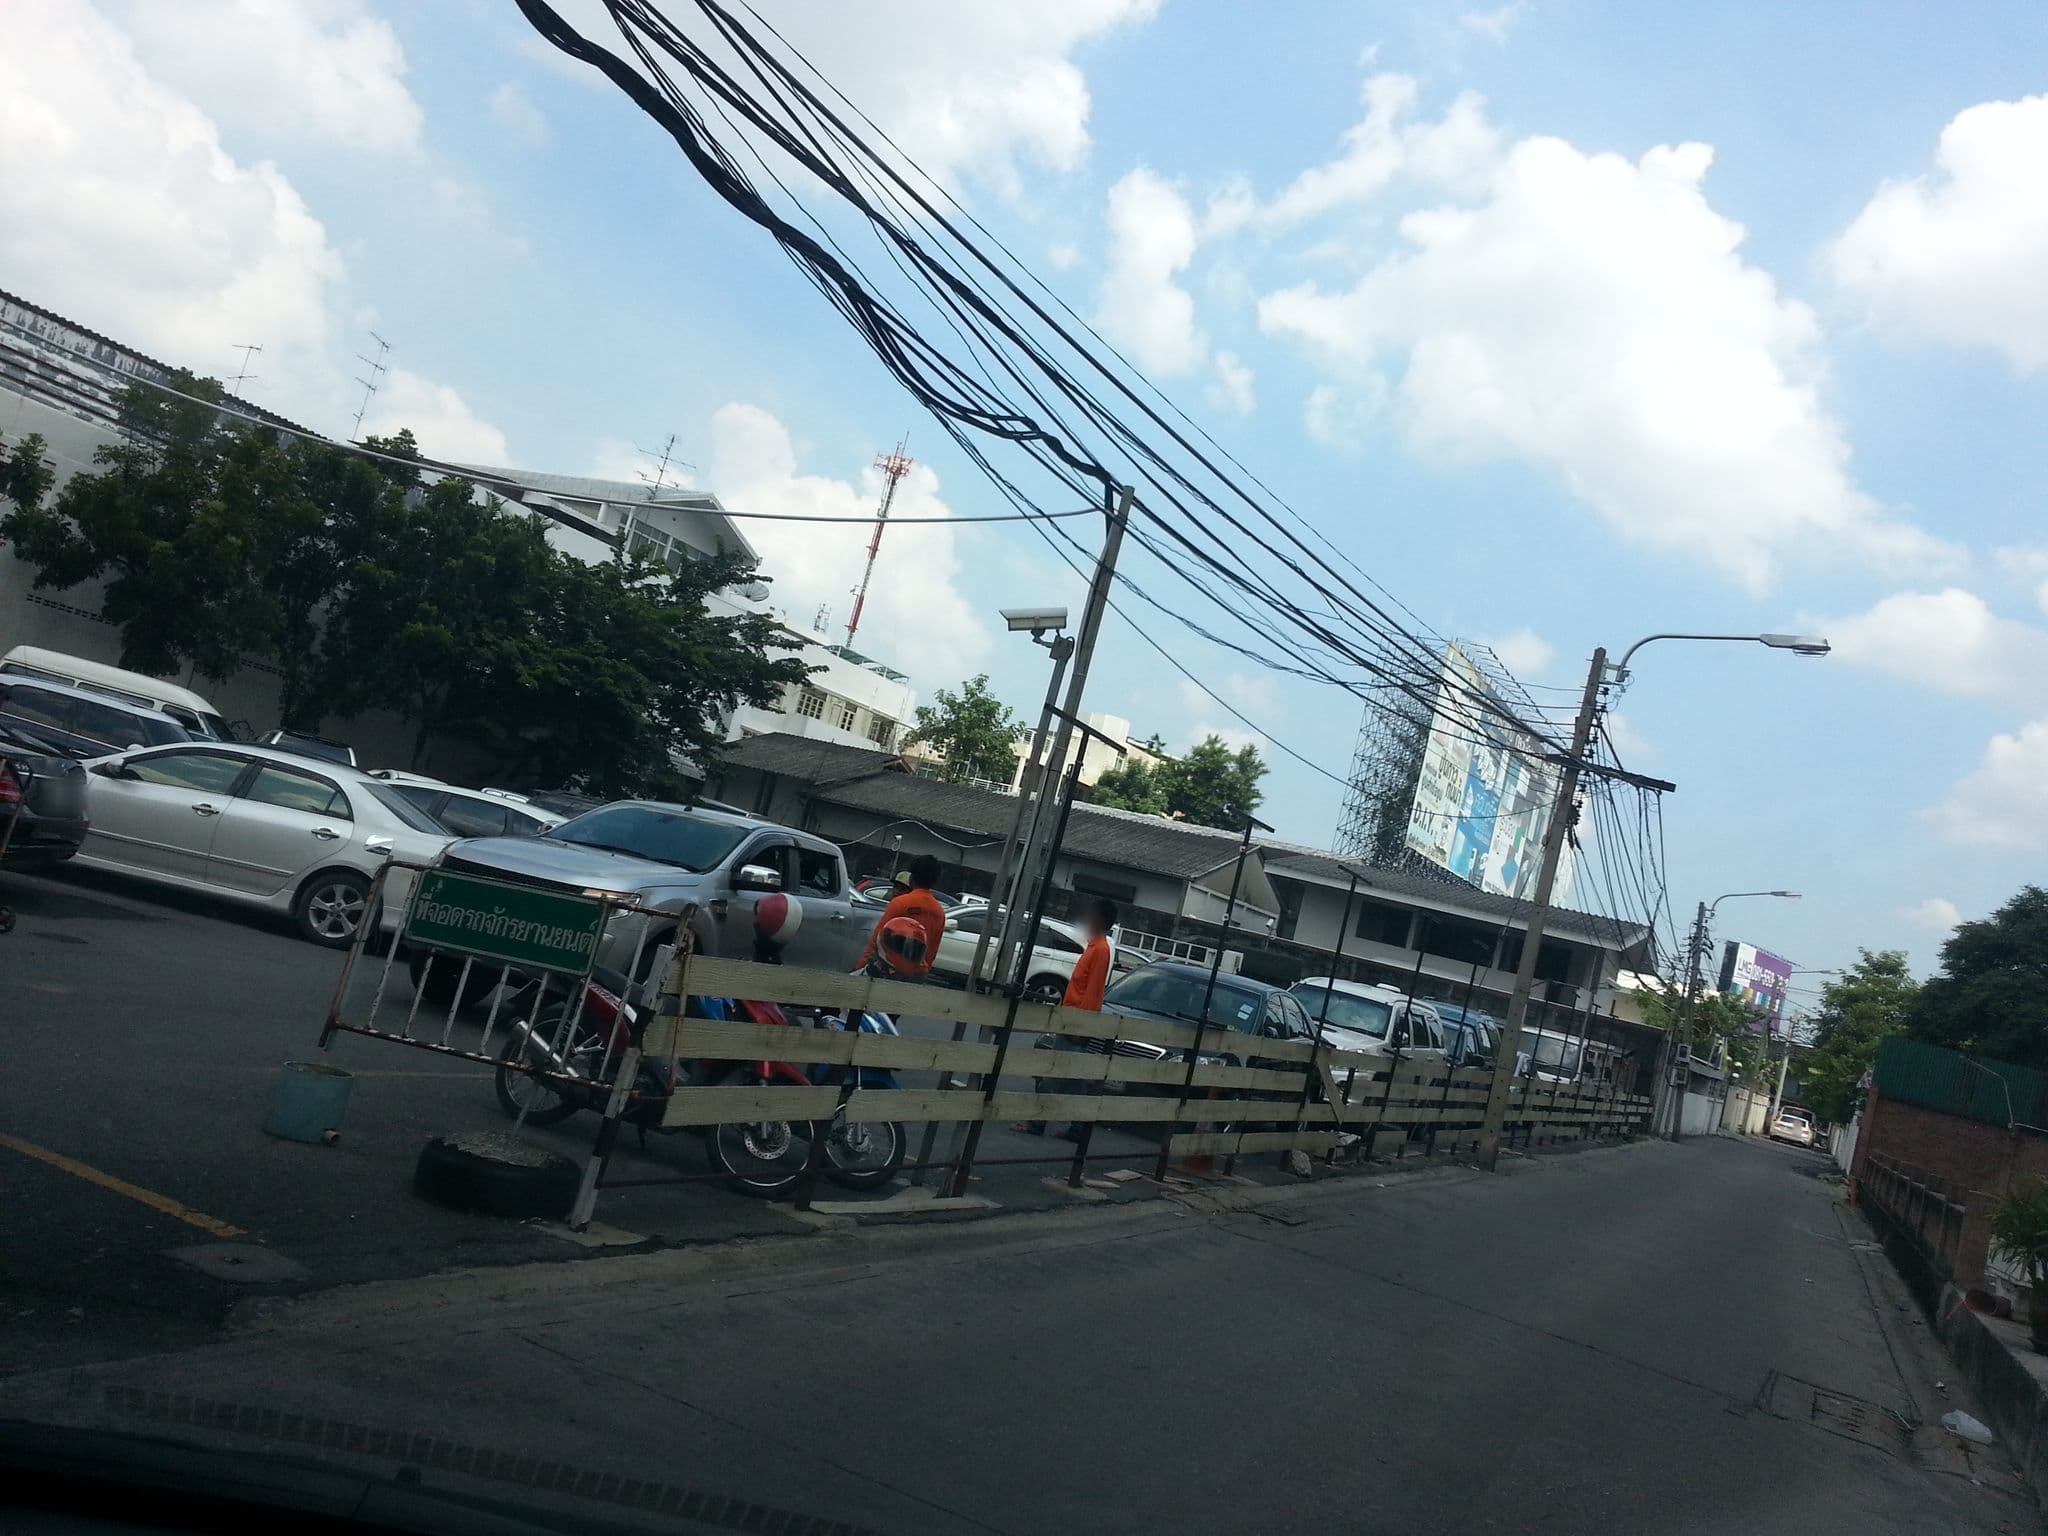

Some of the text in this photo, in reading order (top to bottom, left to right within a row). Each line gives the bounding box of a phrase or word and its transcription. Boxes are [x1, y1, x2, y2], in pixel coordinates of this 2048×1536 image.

[415, 885, 599, 954] ที่จอดรถจักรยานยนต์
